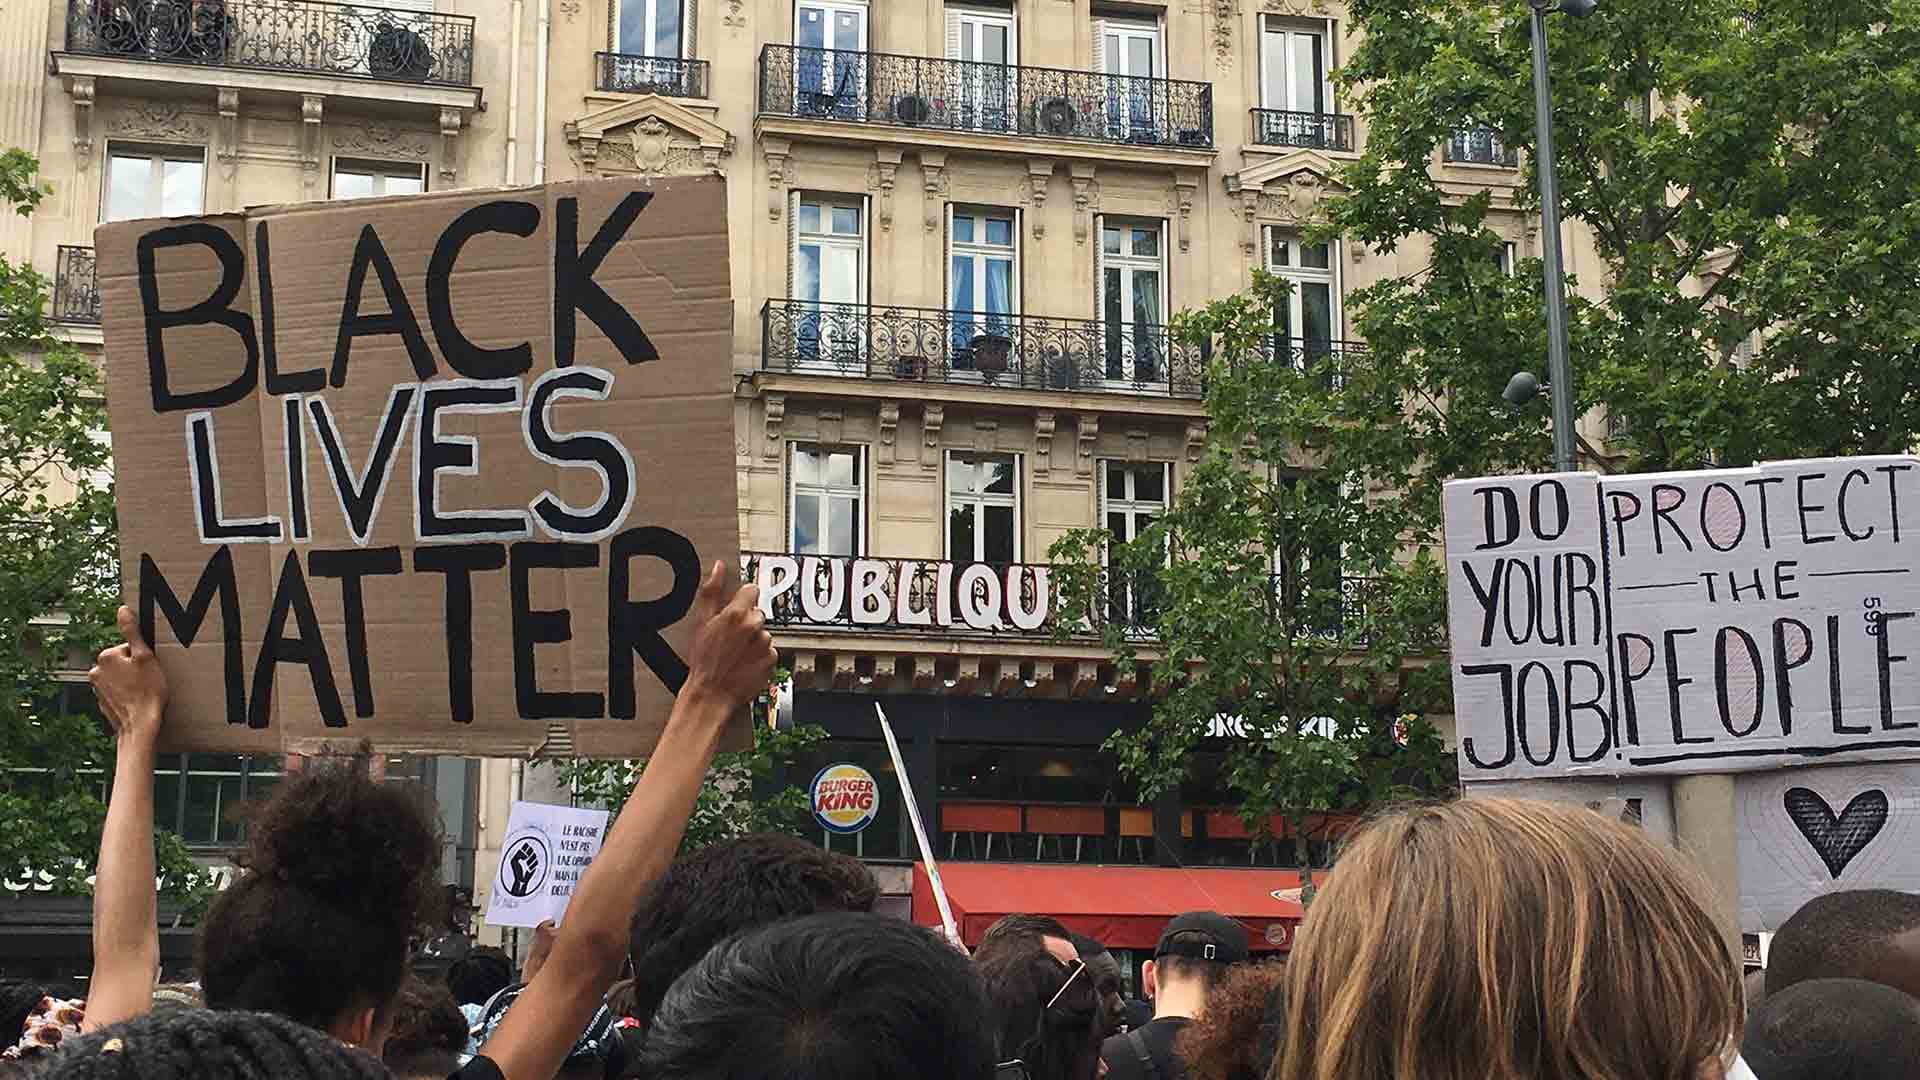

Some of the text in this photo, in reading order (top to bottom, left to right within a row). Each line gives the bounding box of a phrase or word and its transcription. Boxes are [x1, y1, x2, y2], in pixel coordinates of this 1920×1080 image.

[137, 191, 660, 412] BLACK
[186, 365, 636, 544] LIVES
[1473, 479, 1570, 551] DO
[1607, 465, 1912, 557] PROTECT
[139, 526, 704, 728] MATTER
[1461, 552, 1600, 647] YOUR
[1700, 560, 1800, 603] THE
[1617, 611, 1919, 746] PEOPLE
[816, 792, 874, 812] KING
[818, 779, 874, 793] BURGER
